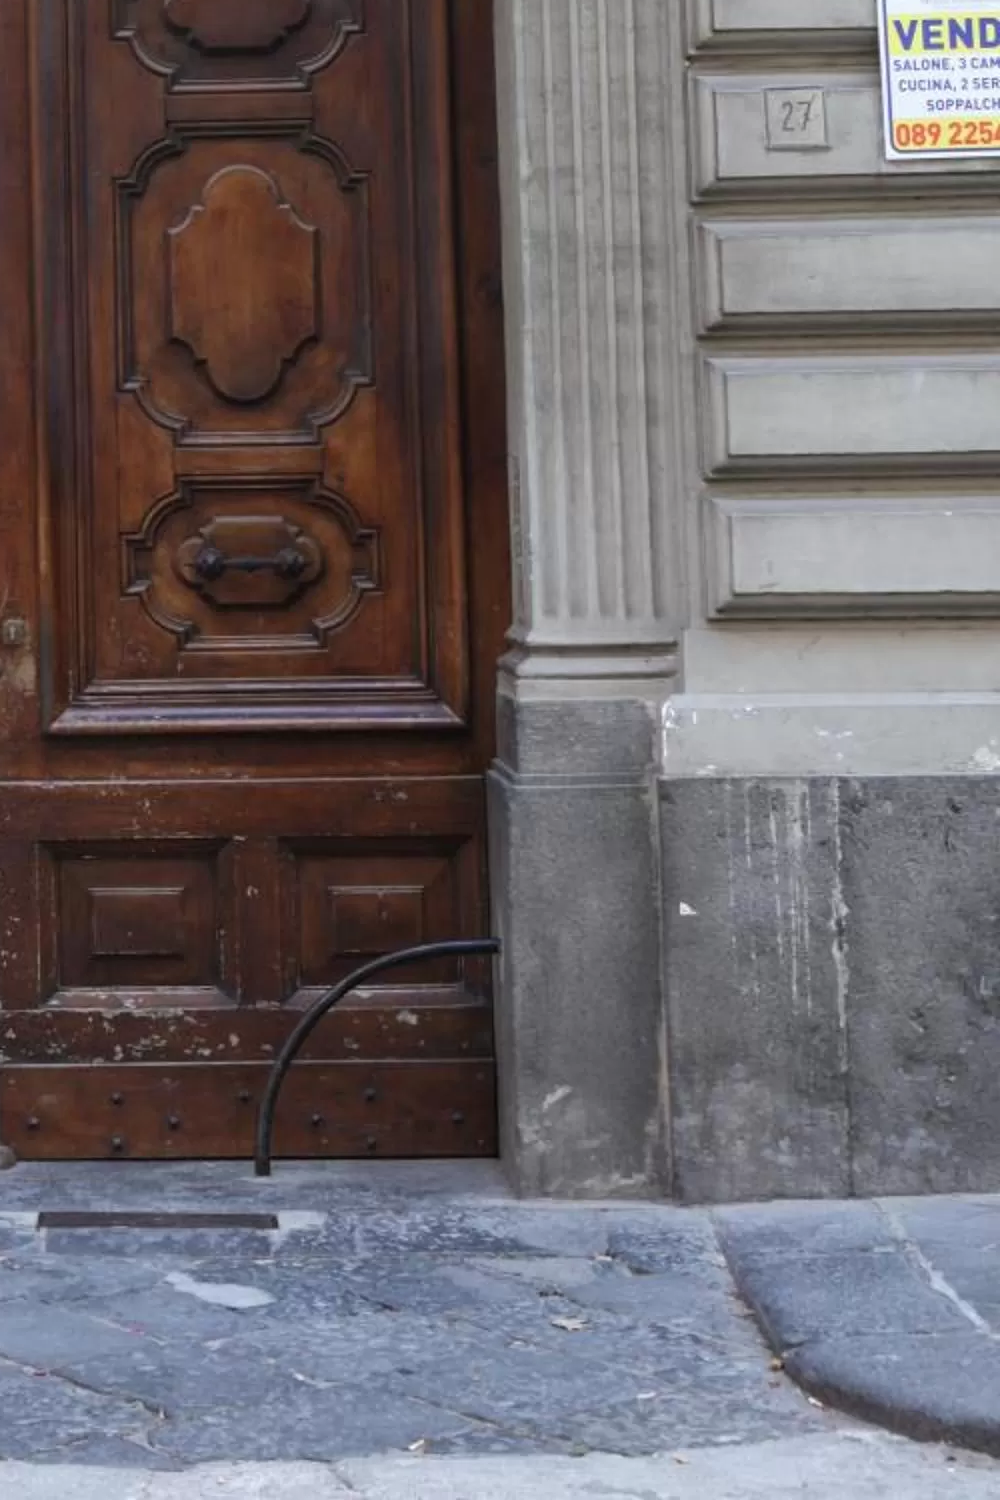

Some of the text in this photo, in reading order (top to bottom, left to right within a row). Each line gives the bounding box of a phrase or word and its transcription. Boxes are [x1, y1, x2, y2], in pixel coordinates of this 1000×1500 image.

[893, 17, 1000, 51] VEND
[893, 57, 955, 71] SALONE,
[959, 57, 967, 69] 3
[899, 78, 956, 92] CUCINA,
[961, 77, 969, 90] 2
[781, 100, 812, 132] 27
[896, 122, 942, 146] 089
